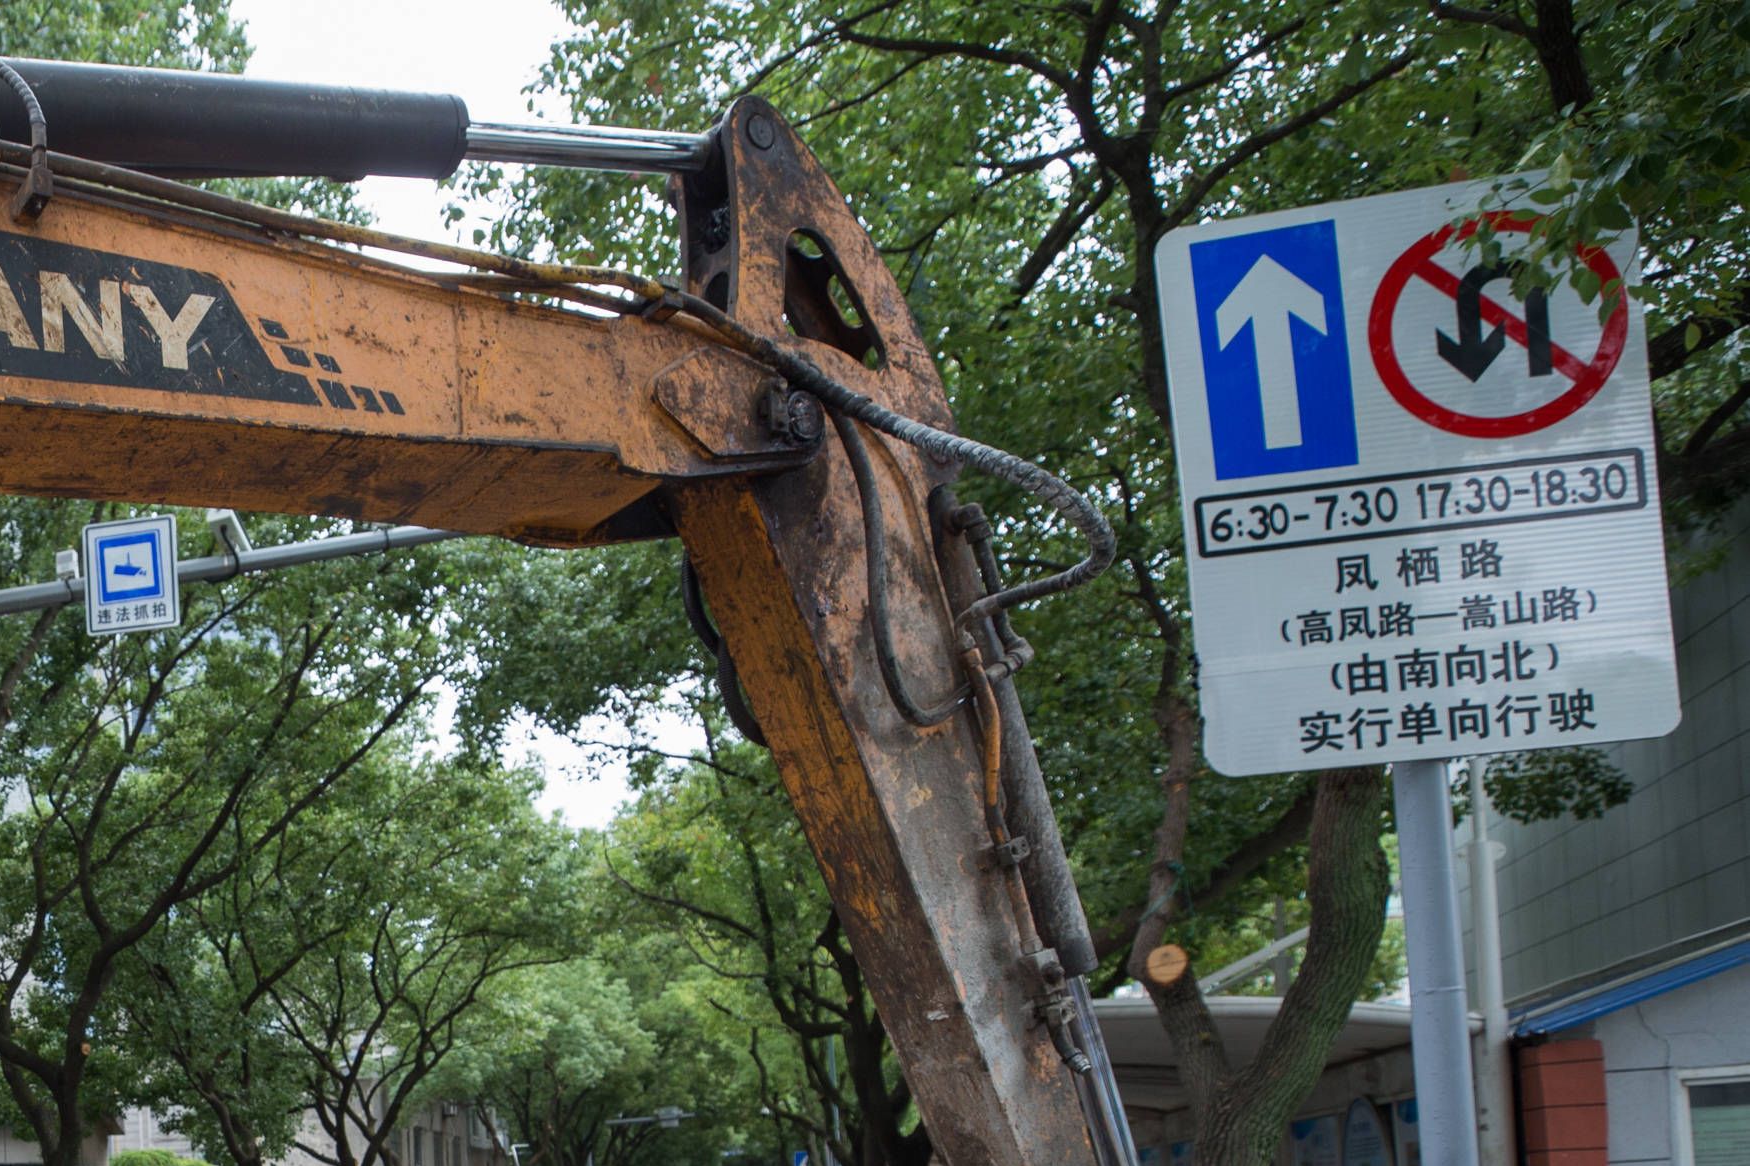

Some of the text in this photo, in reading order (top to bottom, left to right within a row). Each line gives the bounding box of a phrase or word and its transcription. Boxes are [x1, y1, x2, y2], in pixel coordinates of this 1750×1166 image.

[1416, 463, 1628, 520] 17:30-18:30
[1335, 538, 1503, 594] 凤栖路
[98, 602, 167, 624] 违法抓拍
[1299, 688, 1598, 754] 实行单向行驶
